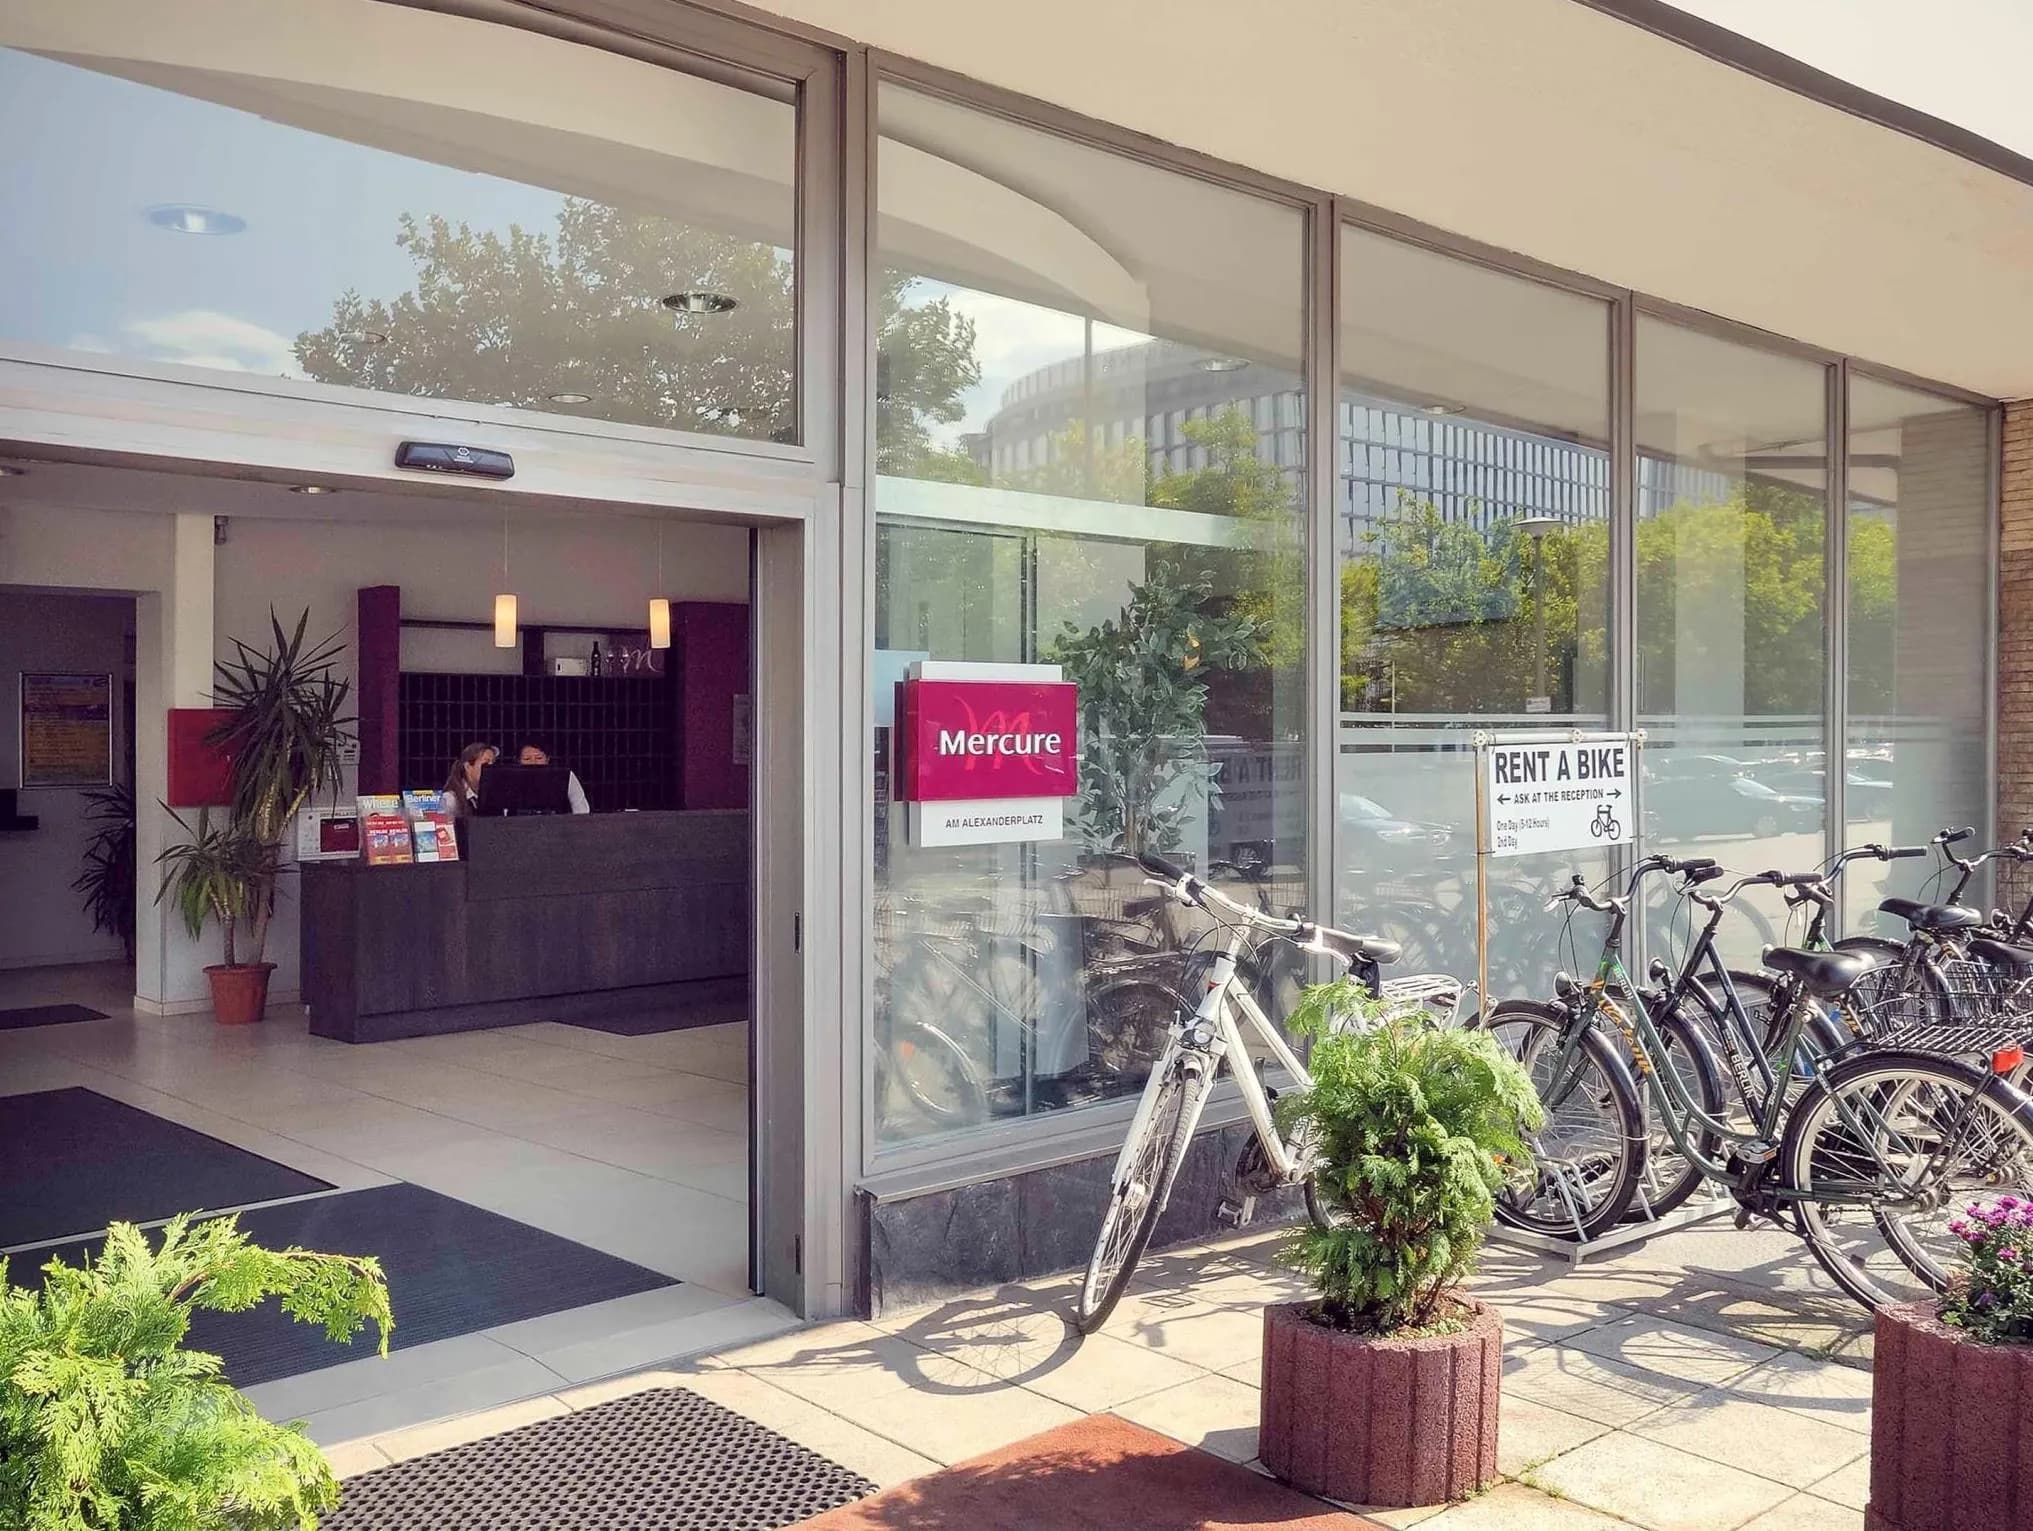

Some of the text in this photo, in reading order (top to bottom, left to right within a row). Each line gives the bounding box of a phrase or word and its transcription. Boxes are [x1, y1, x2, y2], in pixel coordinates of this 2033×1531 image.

[940, 730, 1061, 755] Mercure
[1495, 748, 1625, 784] RENT A BIKE
[1514, 788, 1604, 804] ASK AT THE RECEPTION
[945, 815, 1043, 828] AM ALEXANDERPLATZ
[1731, 1055, 1755, 1098] BERLIN
